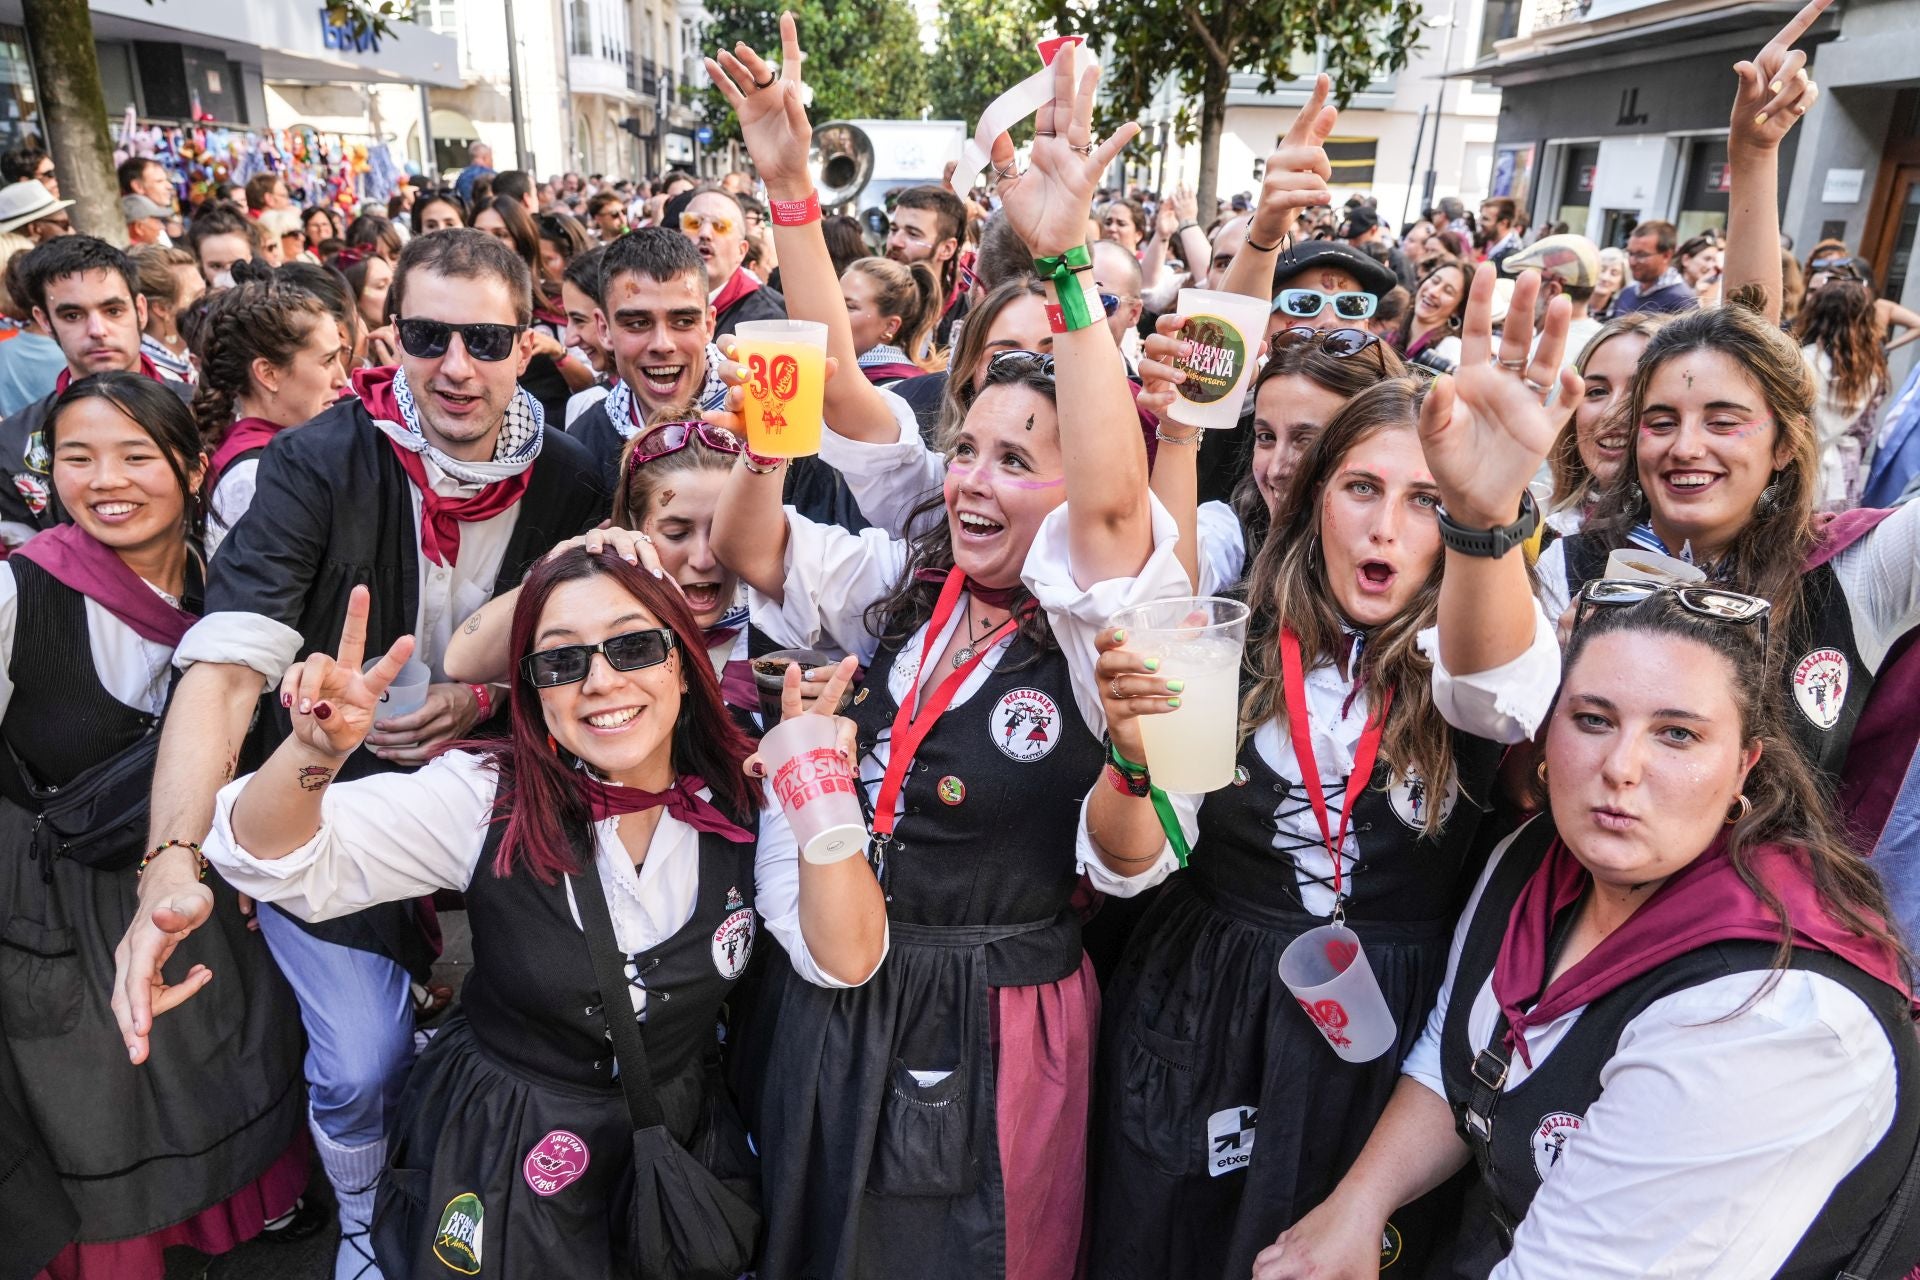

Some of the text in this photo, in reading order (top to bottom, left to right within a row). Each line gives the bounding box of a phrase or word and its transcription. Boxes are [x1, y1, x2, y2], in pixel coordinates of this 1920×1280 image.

[748, 354, 798, 401] 30
[1003, 691, 1055, 714] NEKAZARIAK
[550, 1135, 583, 1153] JAIETAN
[1217, 1154, 1249, 1168] etxe
[531, 1175, 558, 1191] LIBRE
[439, 1234, 454, 1247] X
